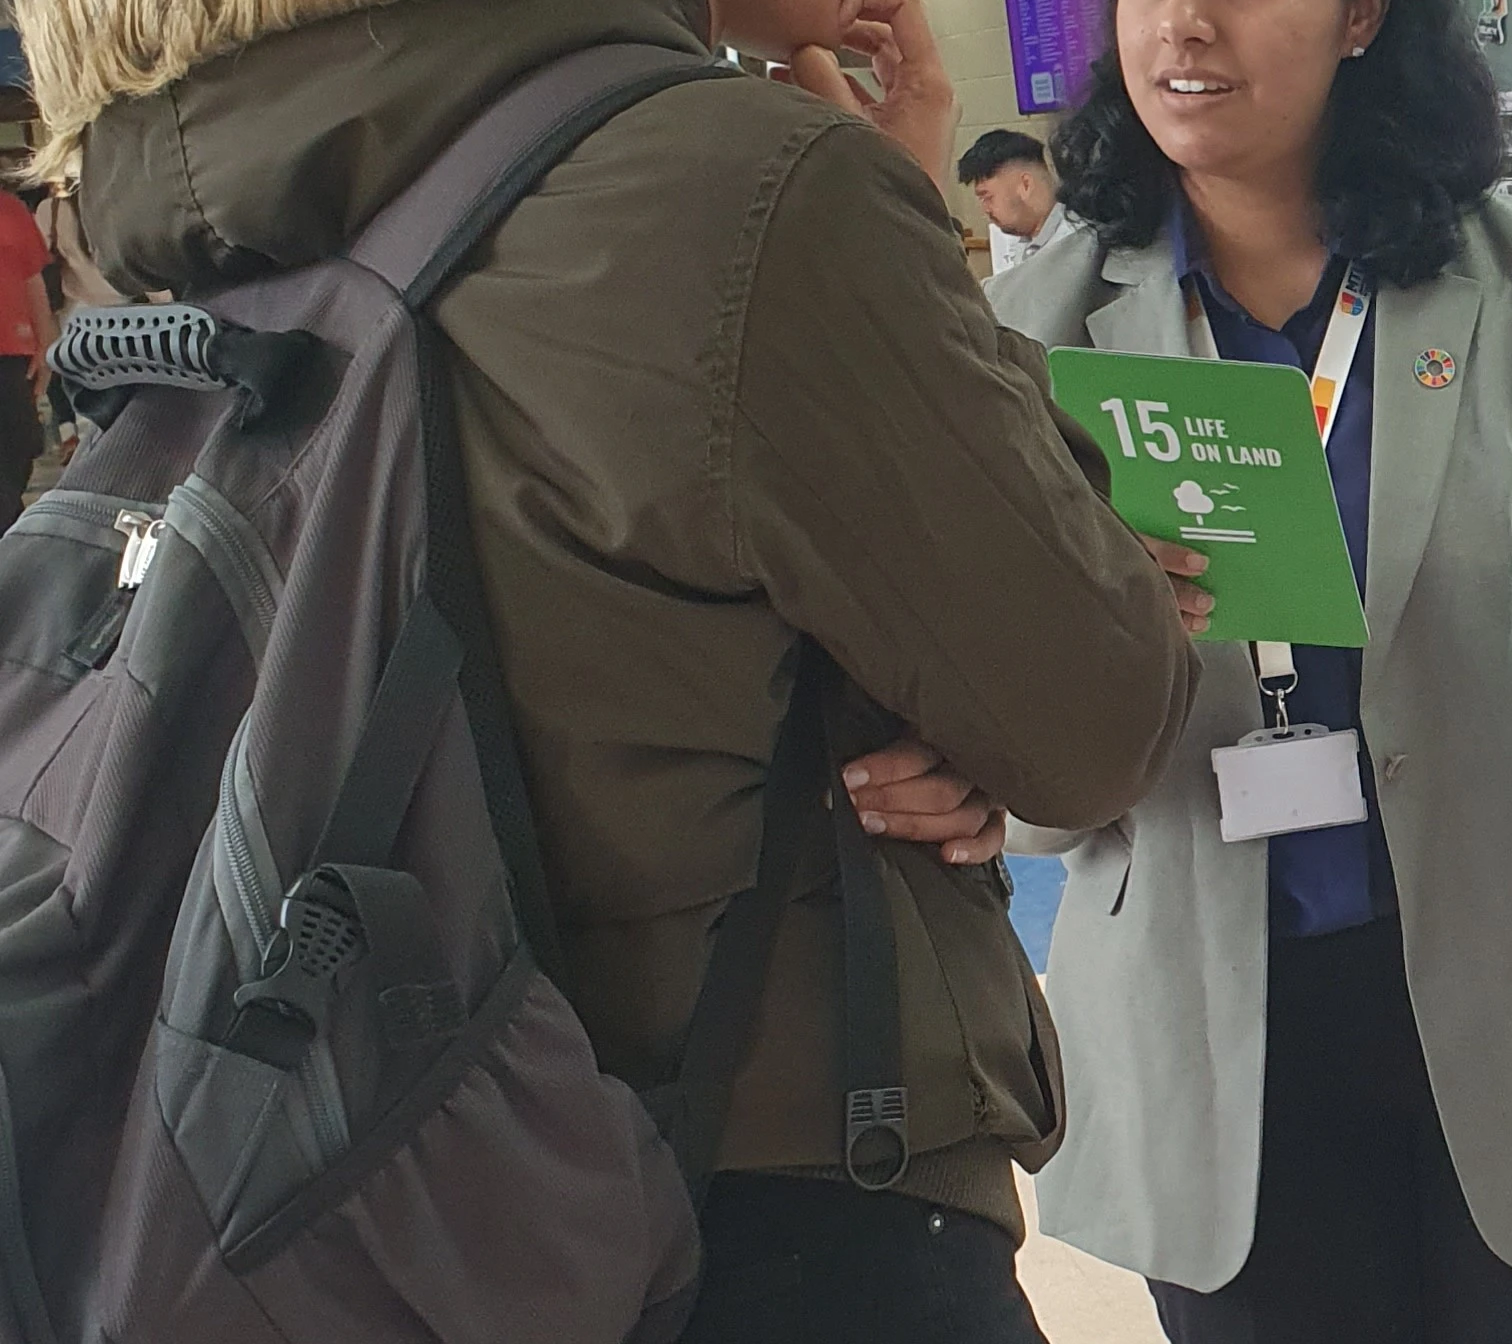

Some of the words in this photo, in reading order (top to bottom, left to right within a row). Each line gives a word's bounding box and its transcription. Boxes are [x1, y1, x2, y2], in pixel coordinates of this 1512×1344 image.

[1100, 397, 1181, 462] 15
[1184, 416, 1229, 439] LIFE
[1190, 442, 1222, 463] ON
[1226, 444, 1283, 468] LAND
